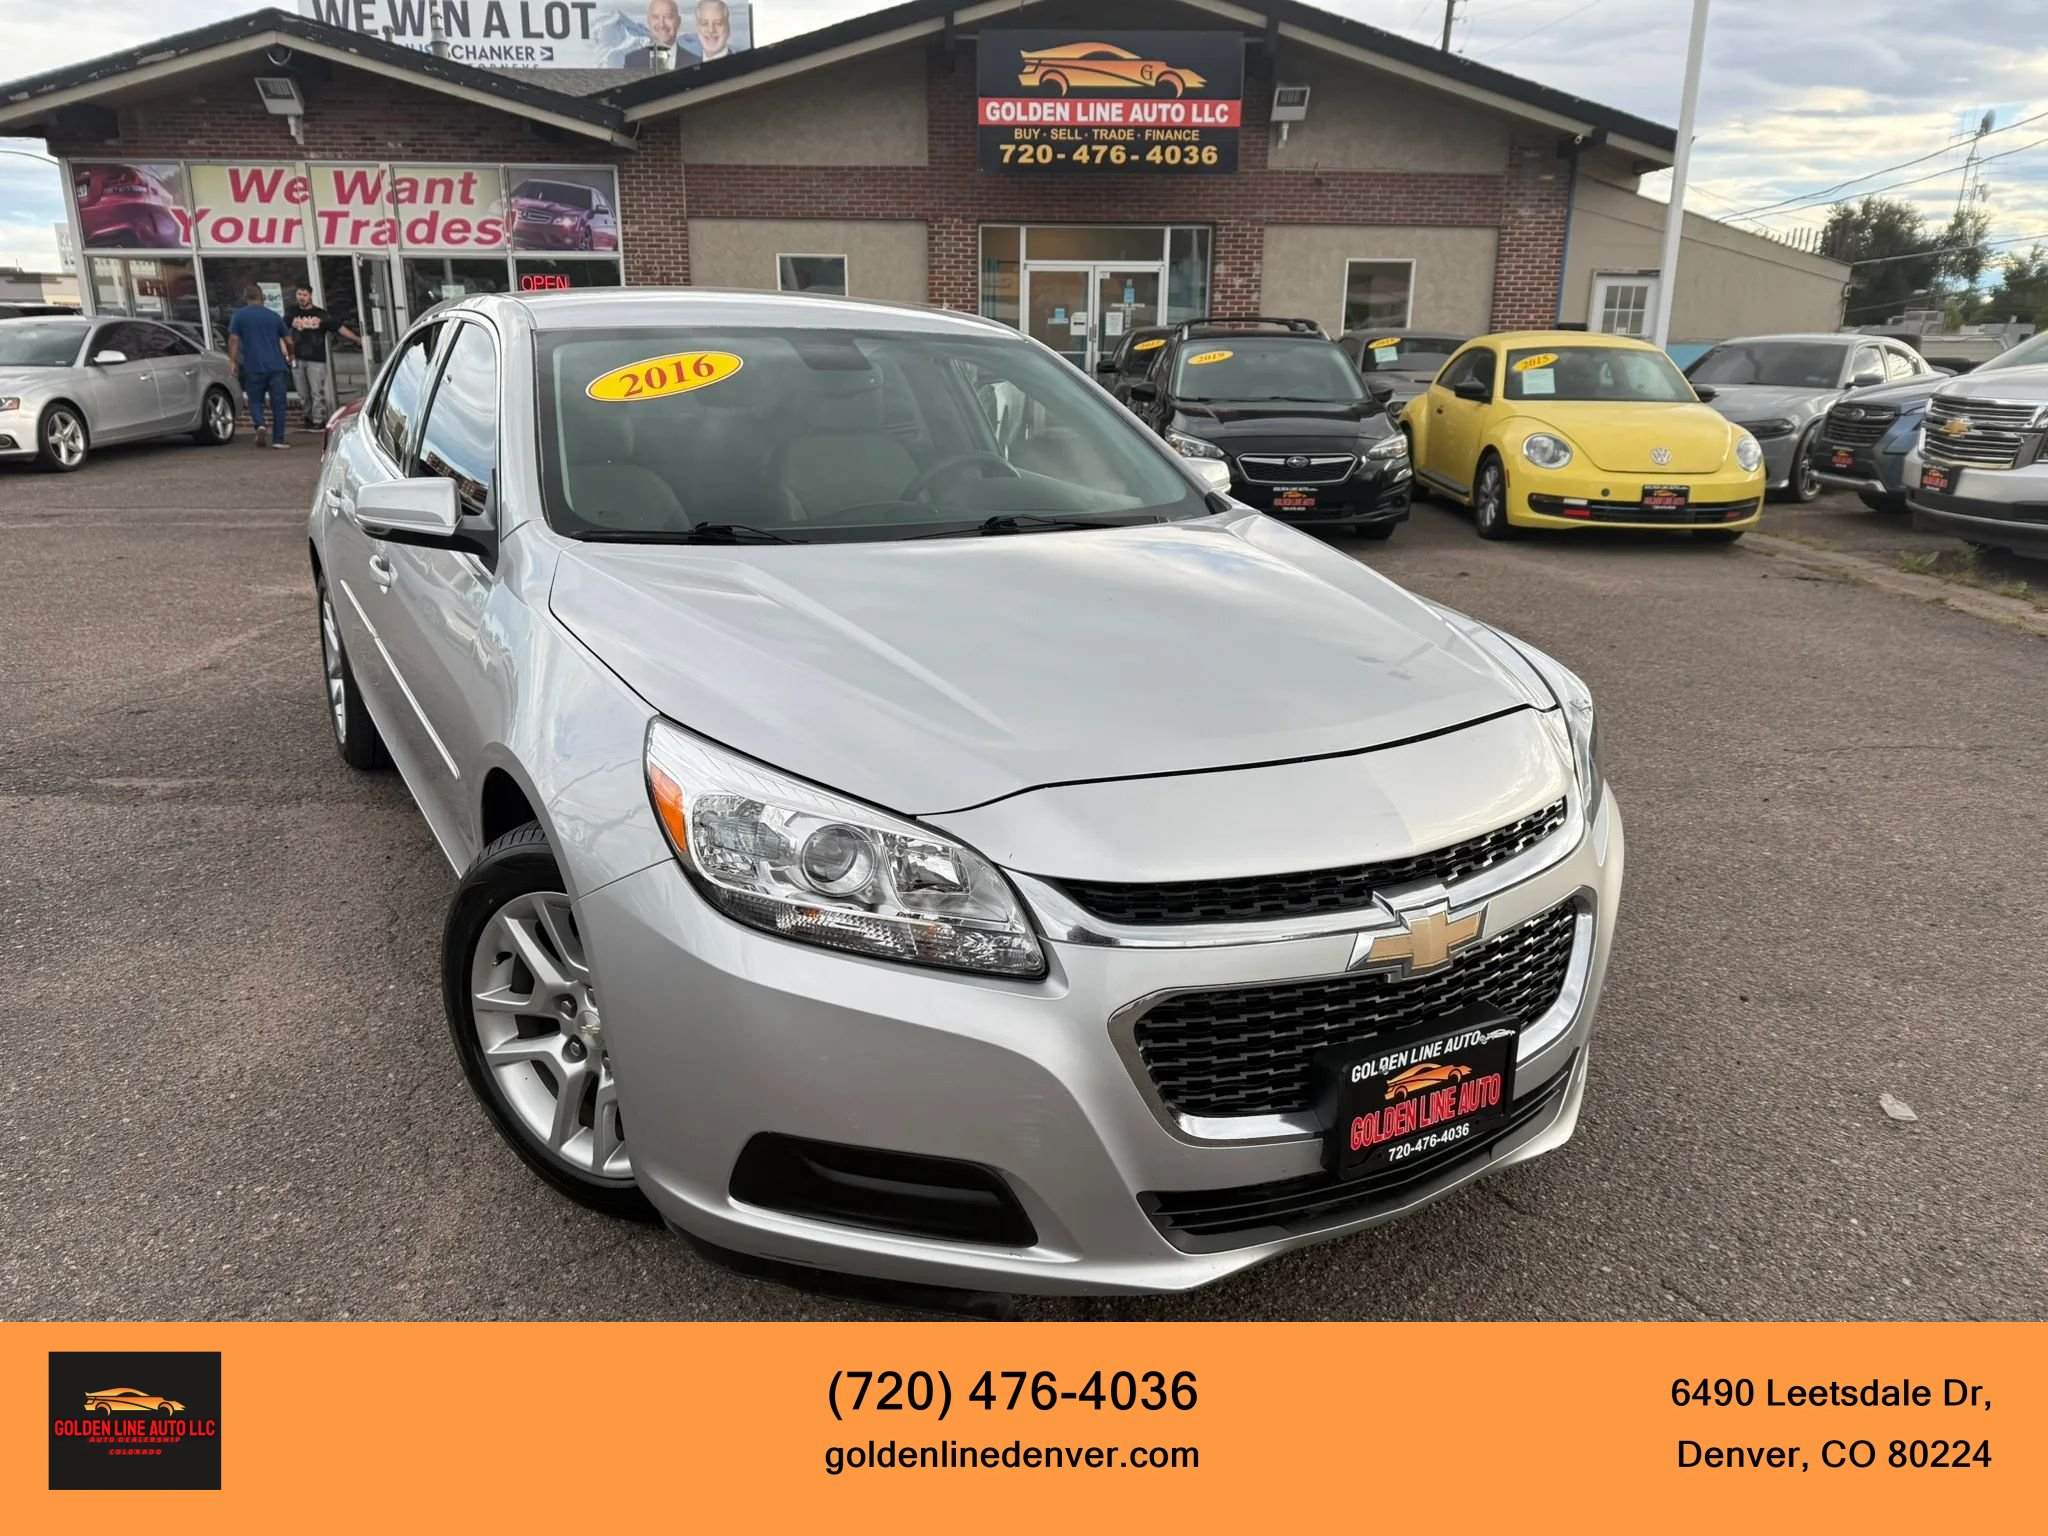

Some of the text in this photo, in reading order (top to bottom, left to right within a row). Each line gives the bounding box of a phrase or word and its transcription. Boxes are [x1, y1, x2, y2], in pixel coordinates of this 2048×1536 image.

[312, 0, 597, 40] WE WN A LOT
[448, 44, 536, 61] CHANKER
[985, 101, 1229, 123] GOLDEN LINE AUTO LLC
[1014, 128, 1200, 141] BUY SELL TRADE FINANCE
[228, 167, 479, 206] We Want
[170, 207, 304, 245] Your
[521, 275, 570, 291] OPEN
[619, 354, 715, 397] 2016
[1521, 355, 1550, 369] 2015
[1351, 1030, 1482, 1083] GOLDEN LINE AUTO
[1350, 1072, 1501, 1151] GOLDEN LINE AUTO
[1388, 1122, 1470, 1162] 720-476-4036
